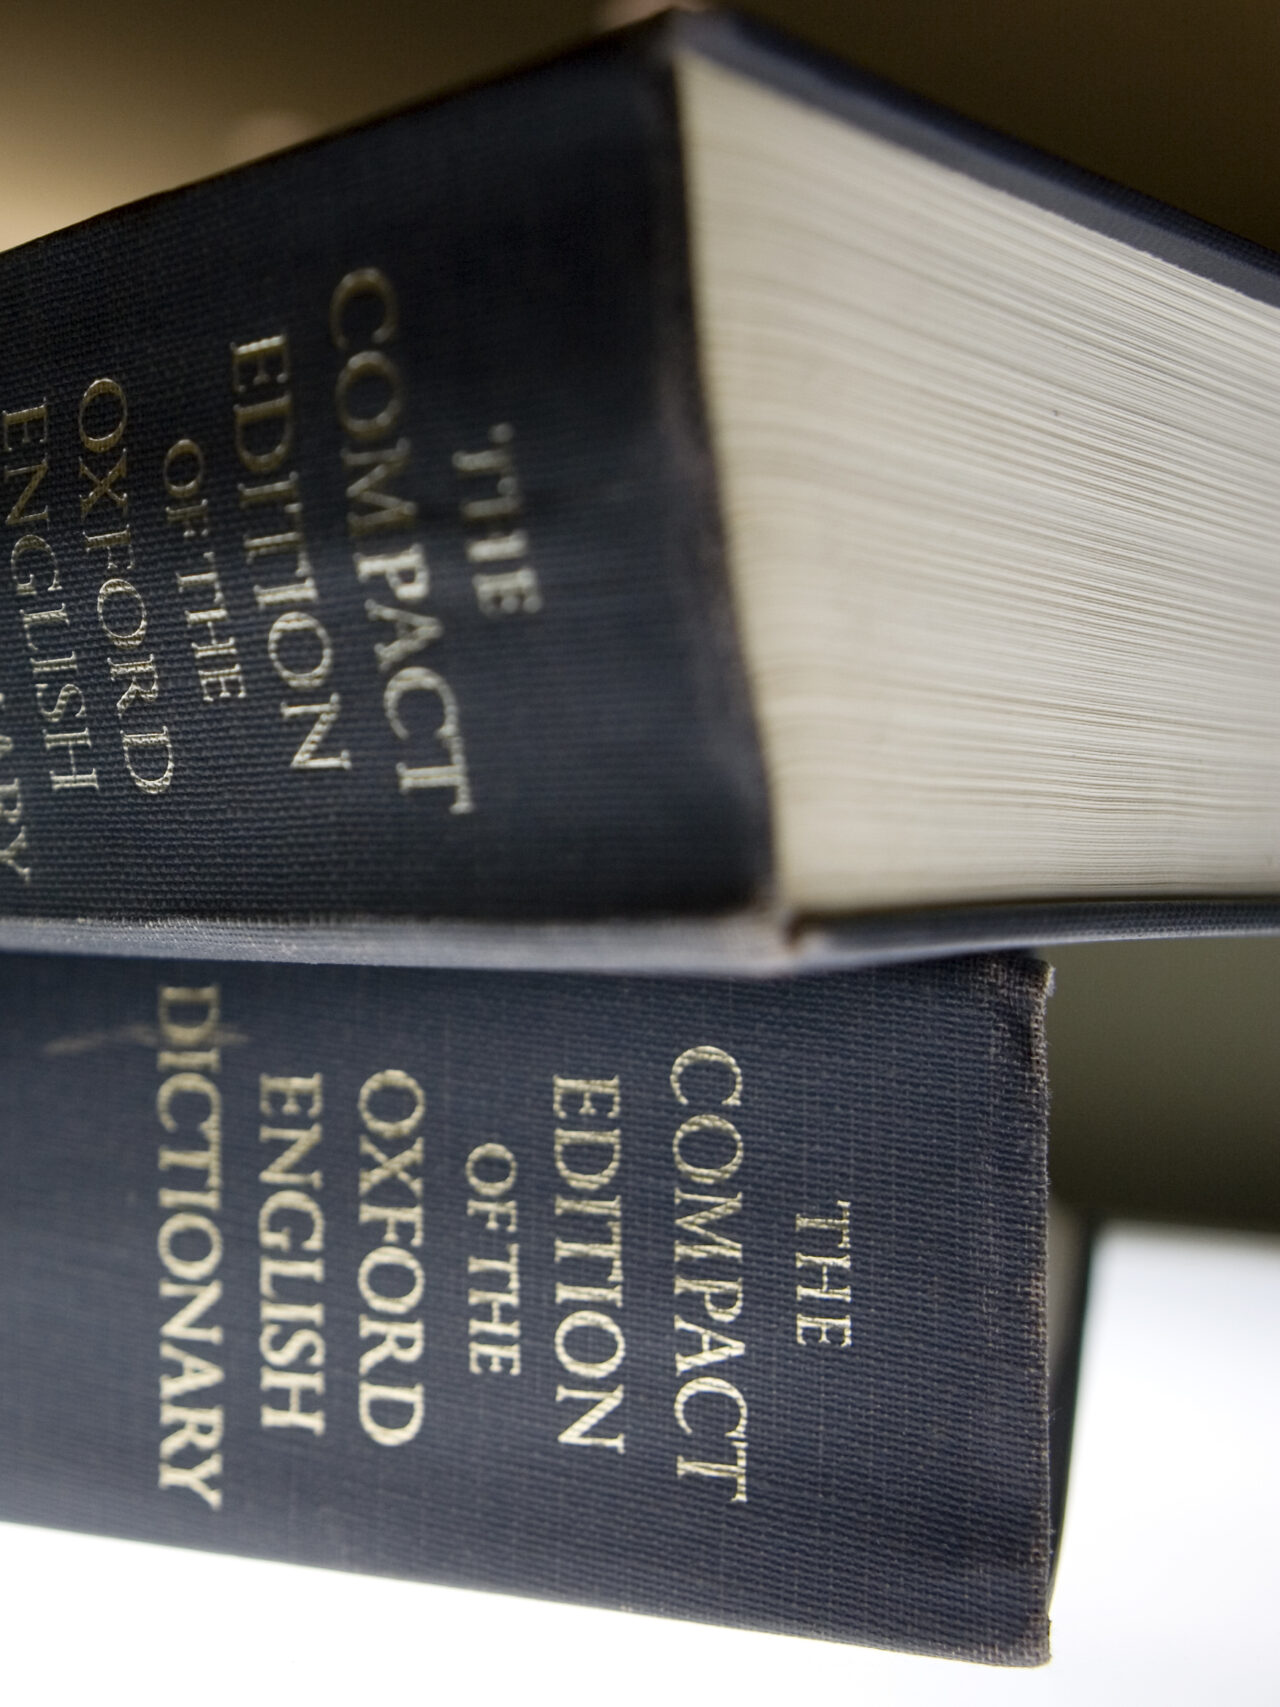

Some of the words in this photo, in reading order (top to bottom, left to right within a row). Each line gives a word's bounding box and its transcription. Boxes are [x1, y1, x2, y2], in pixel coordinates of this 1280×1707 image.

[2, 398, 100, 792] ENGLISH
[78, 377, 175, 795] OXFORD
[162, 439, 211, 537] OF
[175, 552, 246, 702] THE
[230, 333, 353, 772] EDITION
[329, 267, 474, 815] COMPACT
[452, 422, 542, 616] THE
[156, 984, 223, 1510] DICTIONARY
[257, 1072, 326, 1436] ENGLISH
[357, 1068, 426, 1447] OXFORD
[465, 1142, 519, 1235] OF
[466, 1242, 521, 1377] THE
[552, 1073, 627, 1454] EDITION
[669, 1044, 749, 1503] COMPACT
[794, 1200, 853, 1348] THE
